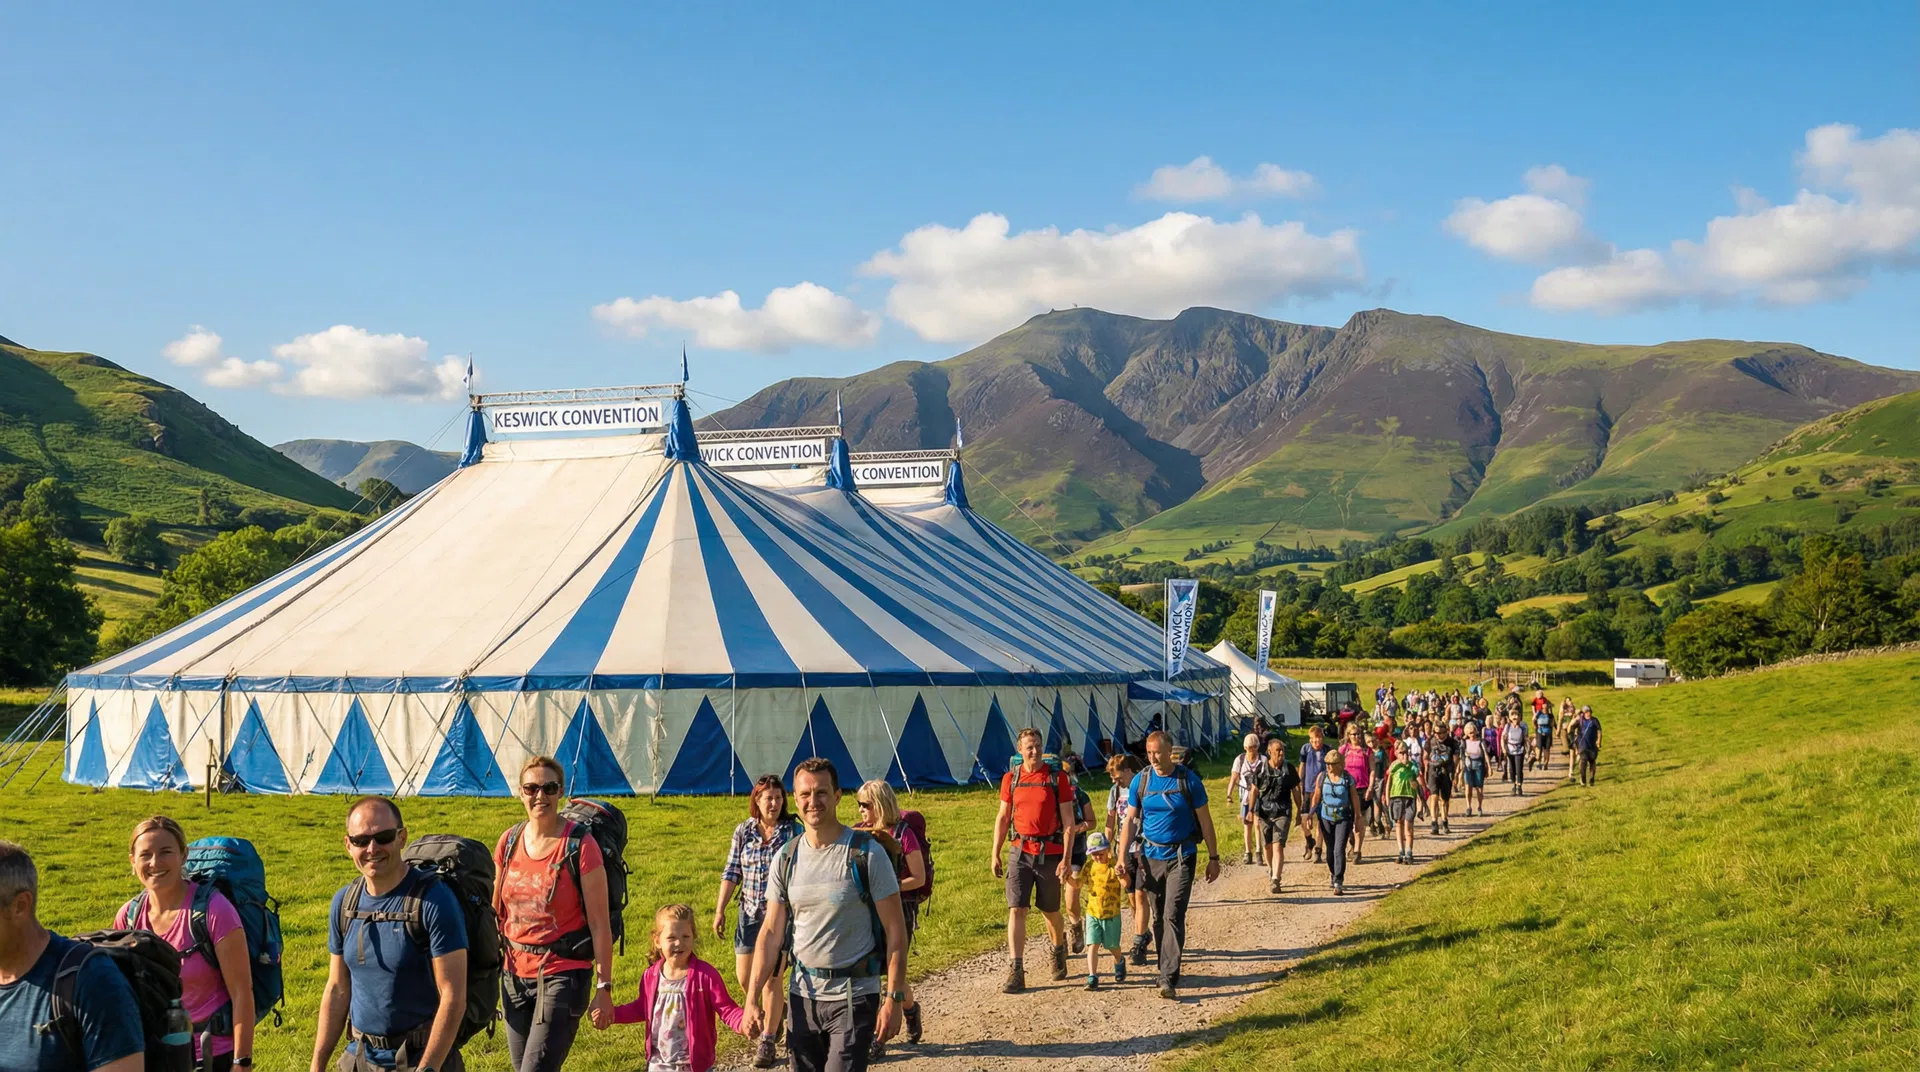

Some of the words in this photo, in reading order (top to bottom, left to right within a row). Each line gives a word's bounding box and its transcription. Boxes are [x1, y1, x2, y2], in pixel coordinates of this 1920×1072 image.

[494, 410, 558, 428] KESWICK
[561, 406, 659, 426] CONVENTION
[700, 447, 735, 462] WICK
[737, 444, 823, 461] CONVENTION
[862, 465, 940, 480] CONVENTION
